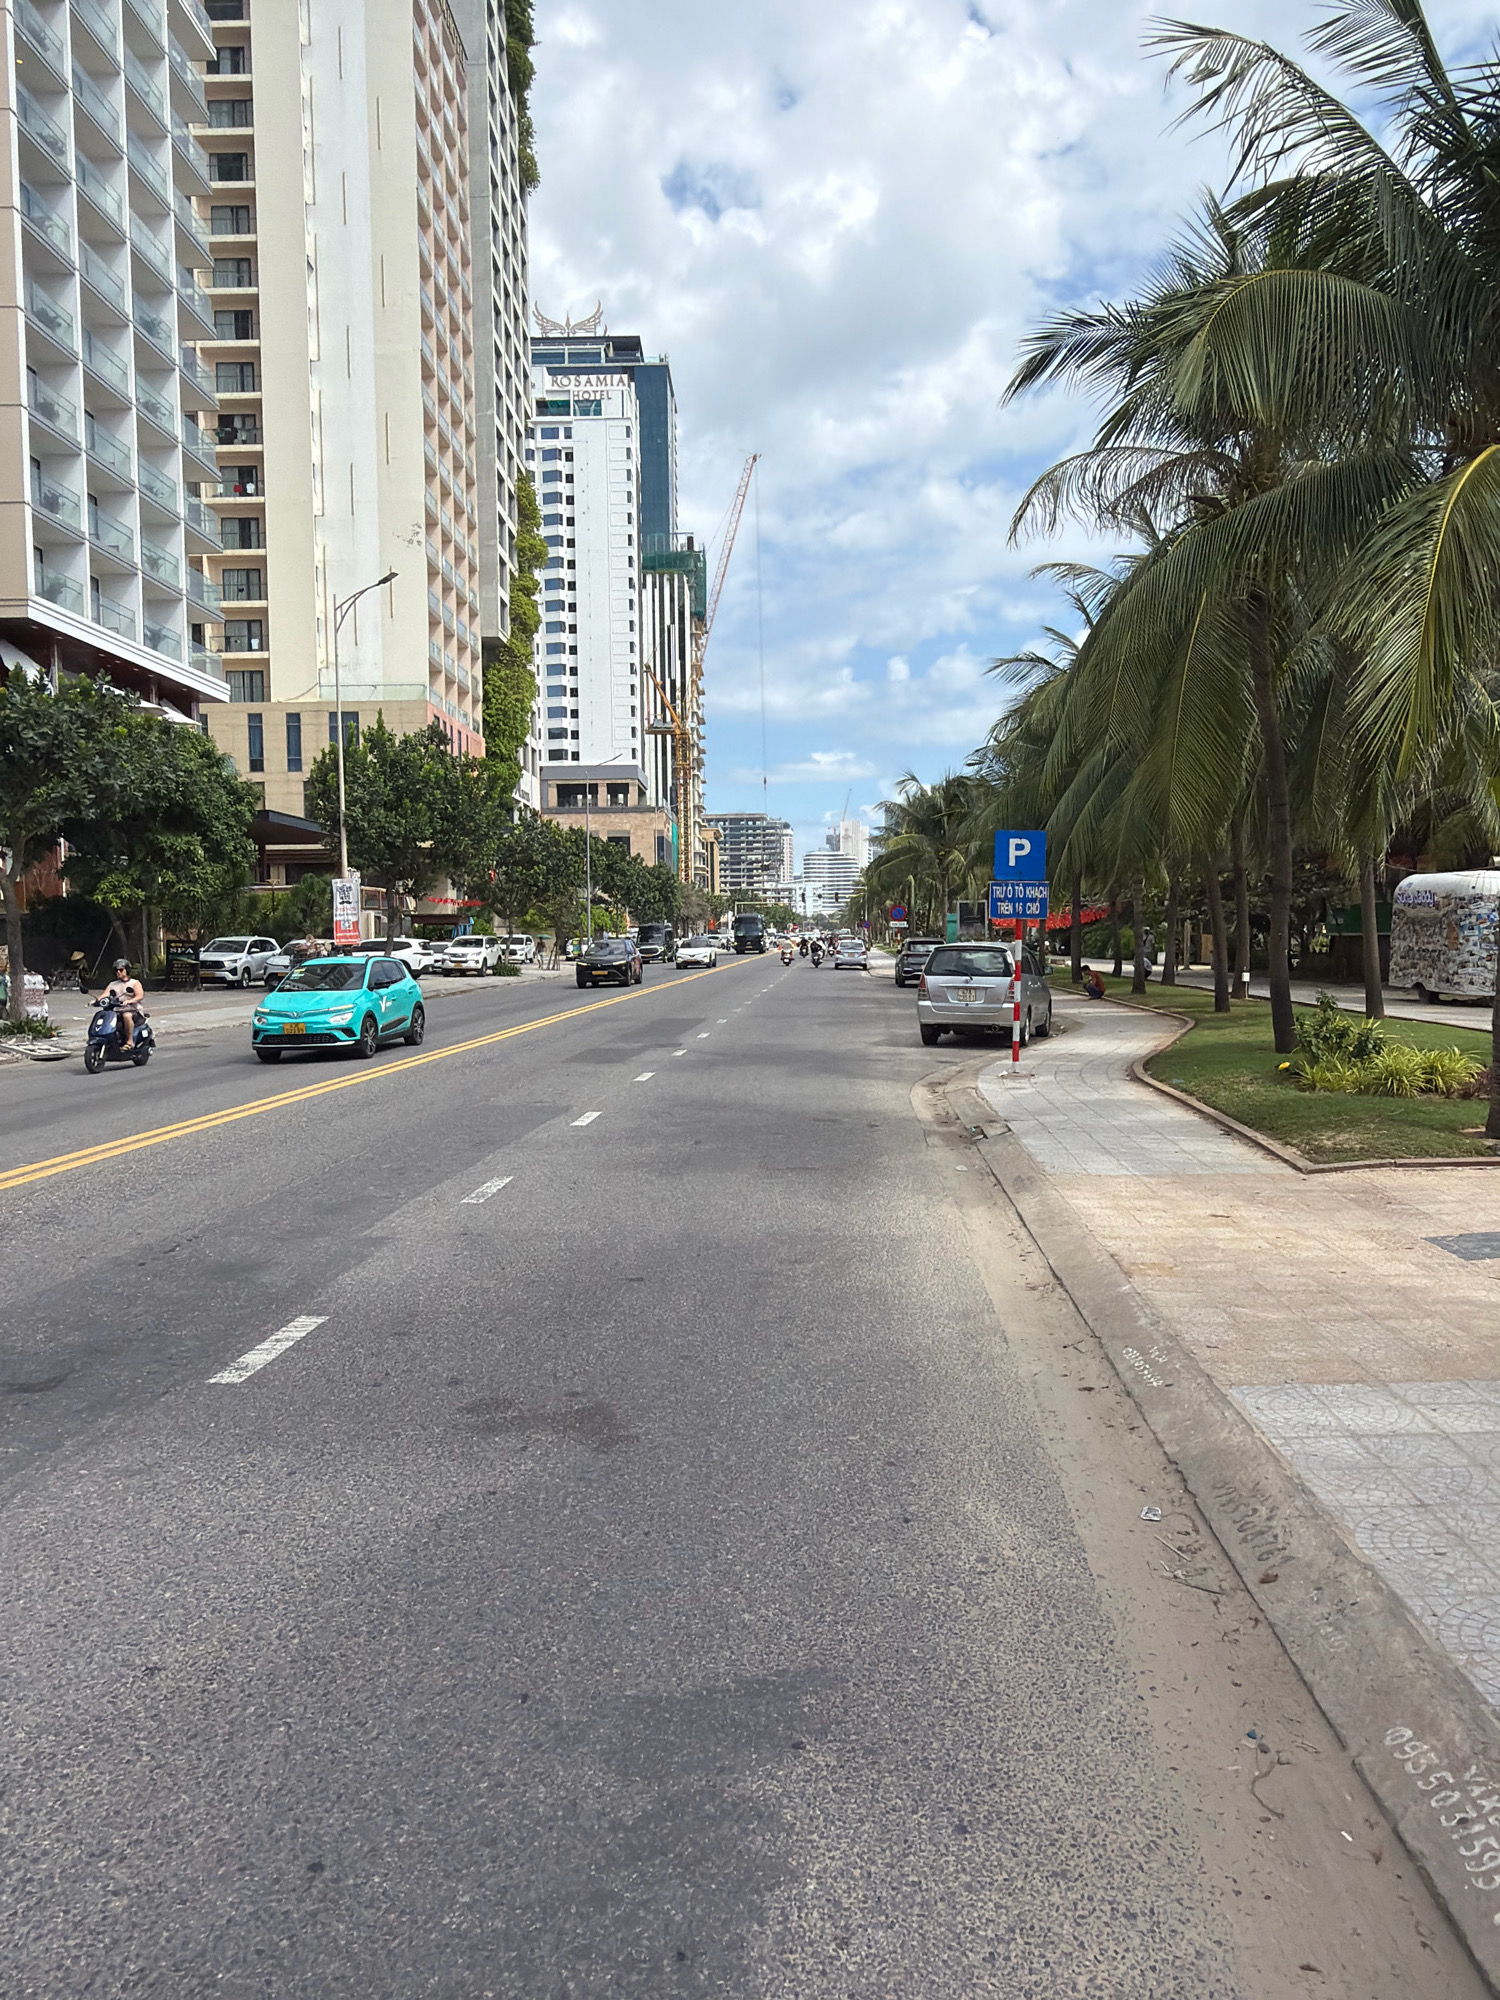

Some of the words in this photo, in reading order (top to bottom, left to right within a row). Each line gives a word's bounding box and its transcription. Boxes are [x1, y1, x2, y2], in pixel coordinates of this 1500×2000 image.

[551, 375, 626, 388] ROSAMIA
[573, 390, 612, 400] HOTEL
[1009, 838, 1031, 866] P
[997, 900, 1013, 915] TRÊN
[1015, 902, 1023, 915] 16
